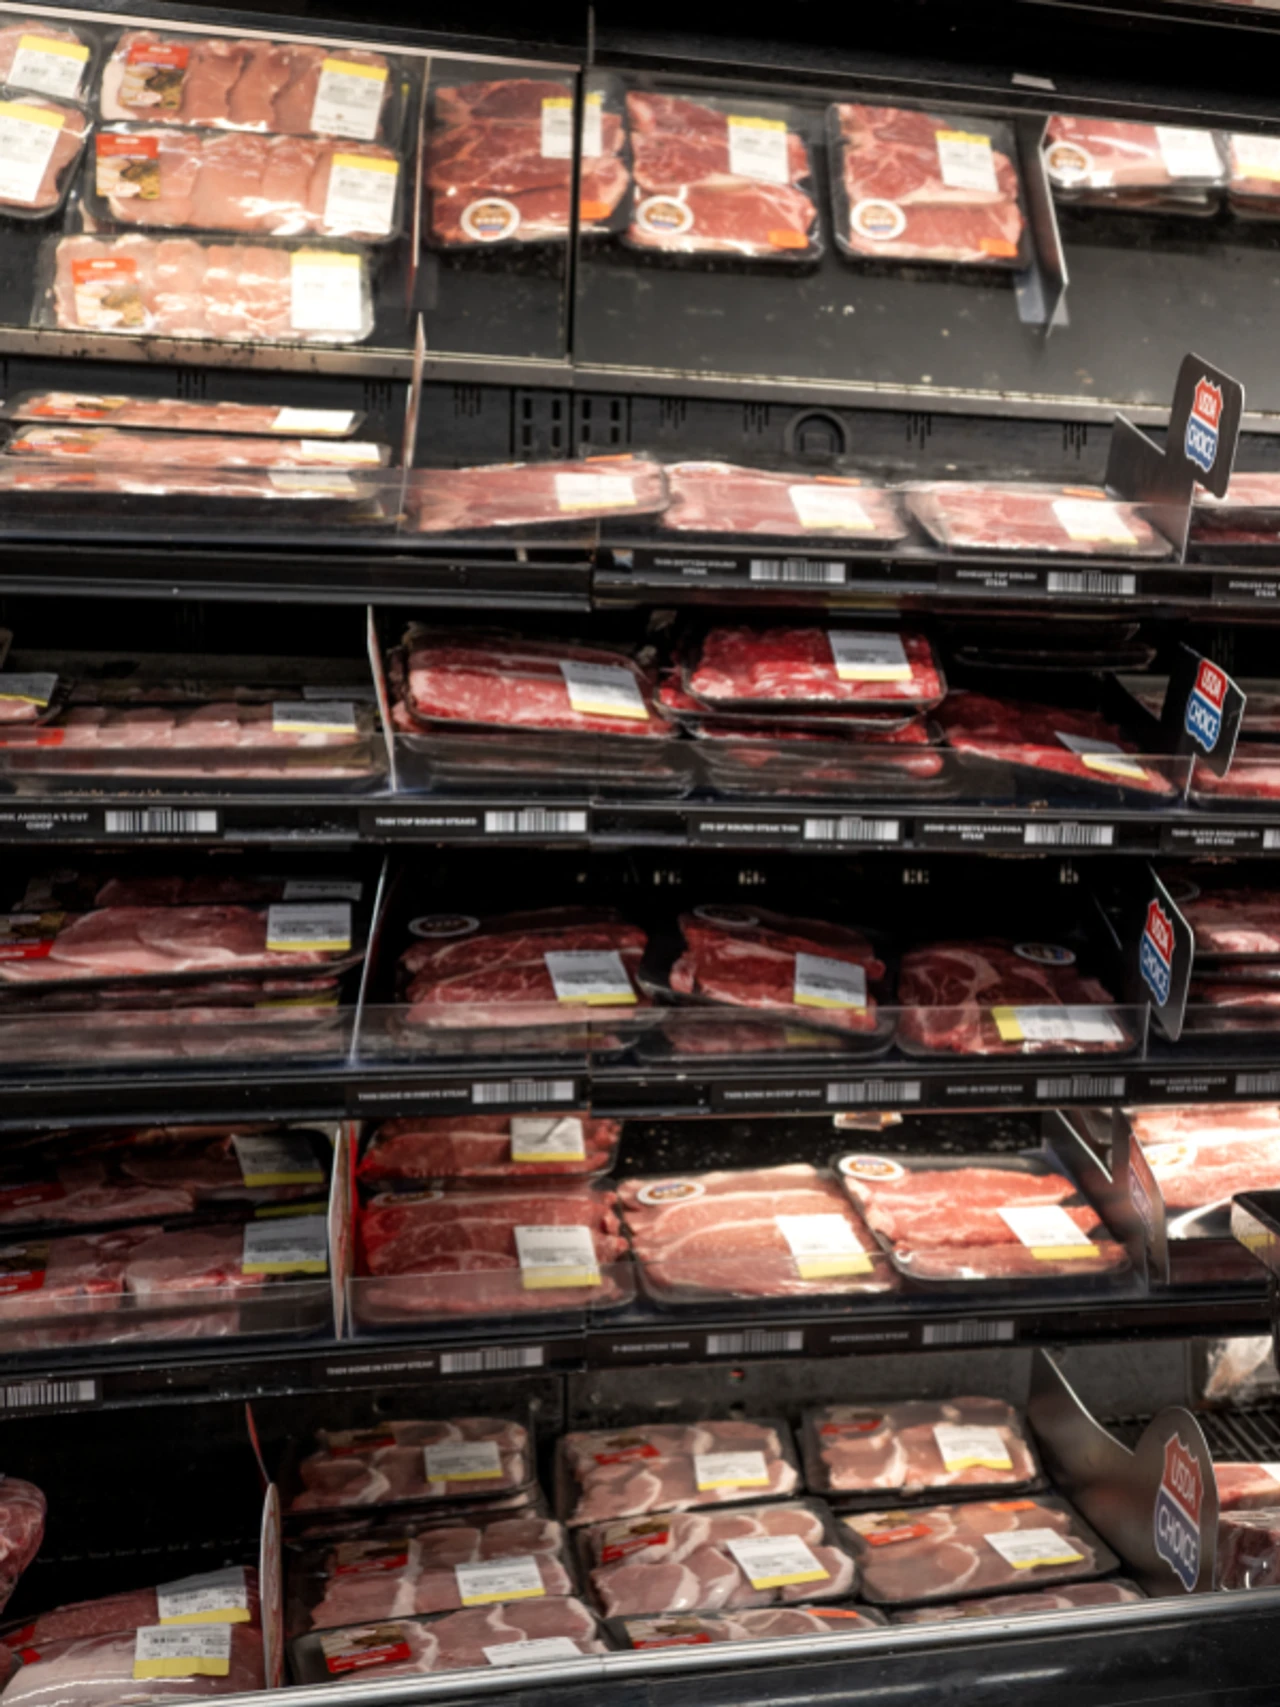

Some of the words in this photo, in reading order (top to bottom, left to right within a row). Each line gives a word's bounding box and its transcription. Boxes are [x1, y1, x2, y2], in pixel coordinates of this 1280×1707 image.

[1189, 424, 1215, 460] CHOICE
[1190, 699, 1218, 740] CHOICE
[1143, 943, 1167, 995] CHOICE
[1171, 1453, 1196, 1510] USDA
[1158, 1504, 1195, 1574] CHOICE
